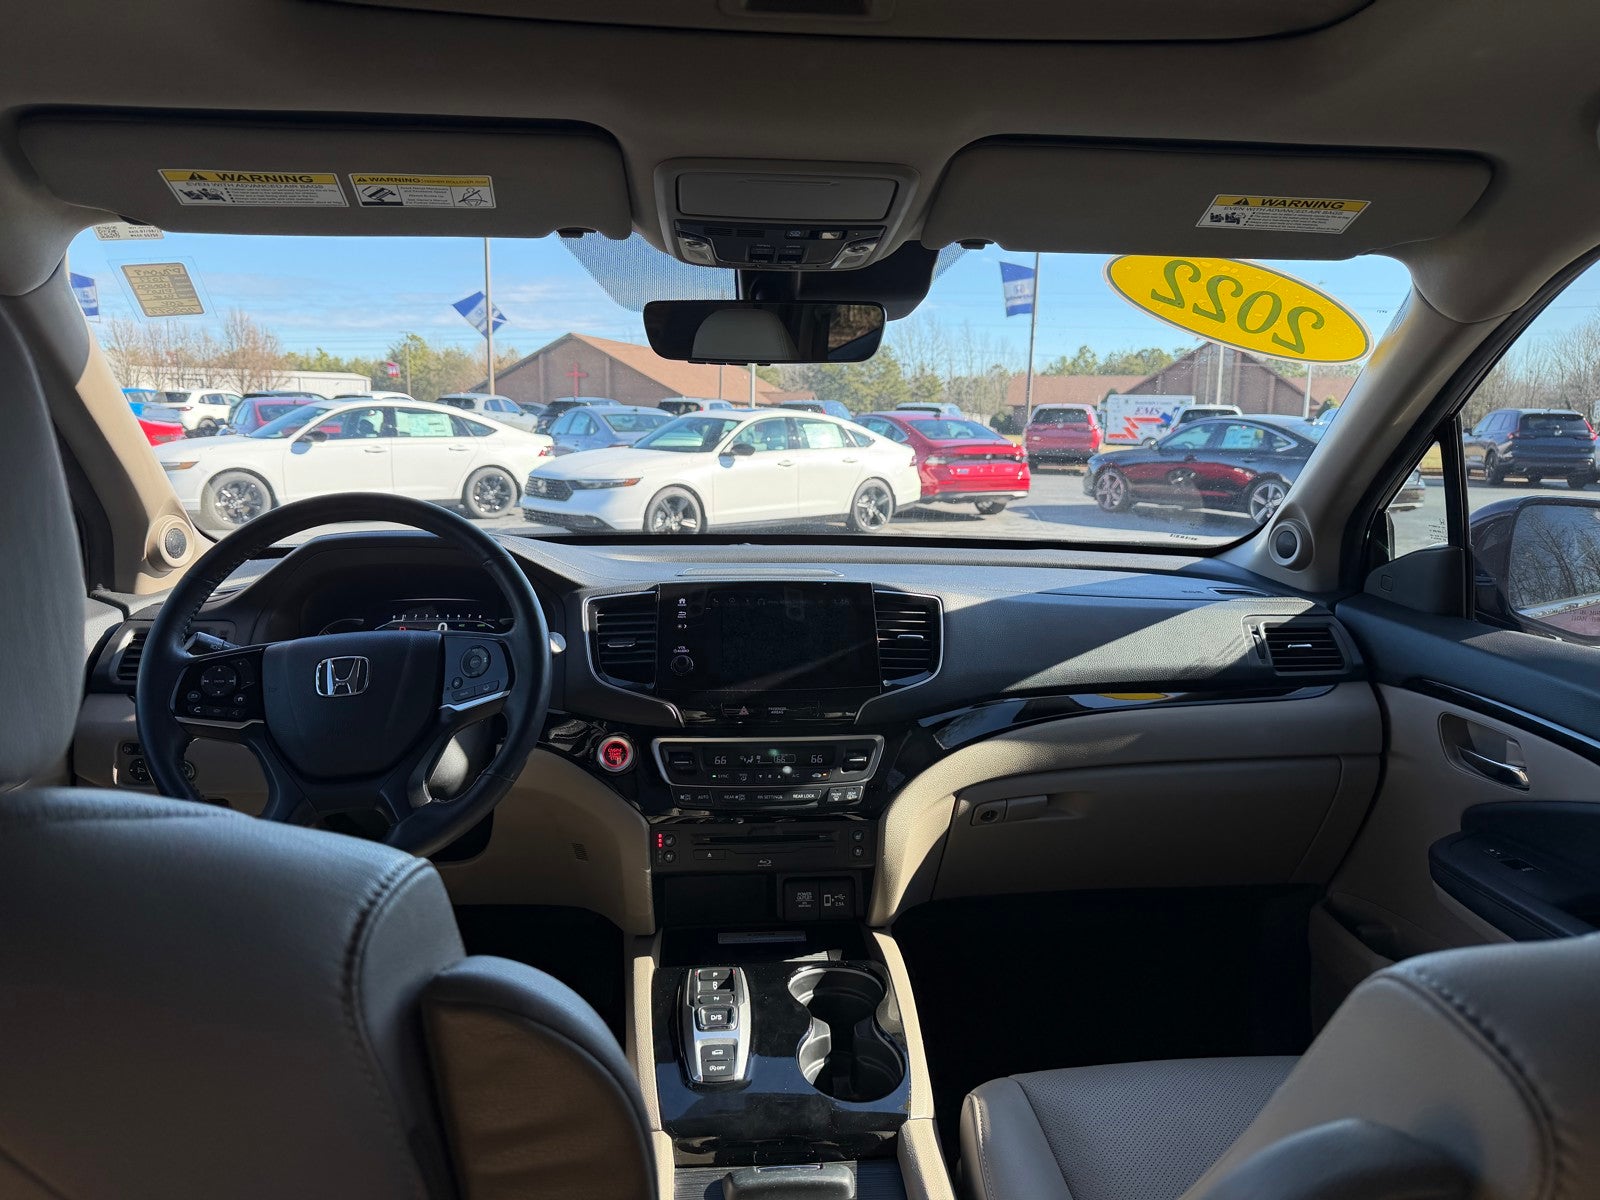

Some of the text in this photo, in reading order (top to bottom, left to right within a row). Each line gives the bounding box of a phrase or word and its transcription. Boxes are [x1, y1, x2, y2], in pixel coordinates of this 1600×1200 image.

[215, 173, 314, 184] WARNING
[1260, 198, 1346, 210] WARNING
[714, 755, 727, 766] 66
[811, 754, 824, 764] 66
